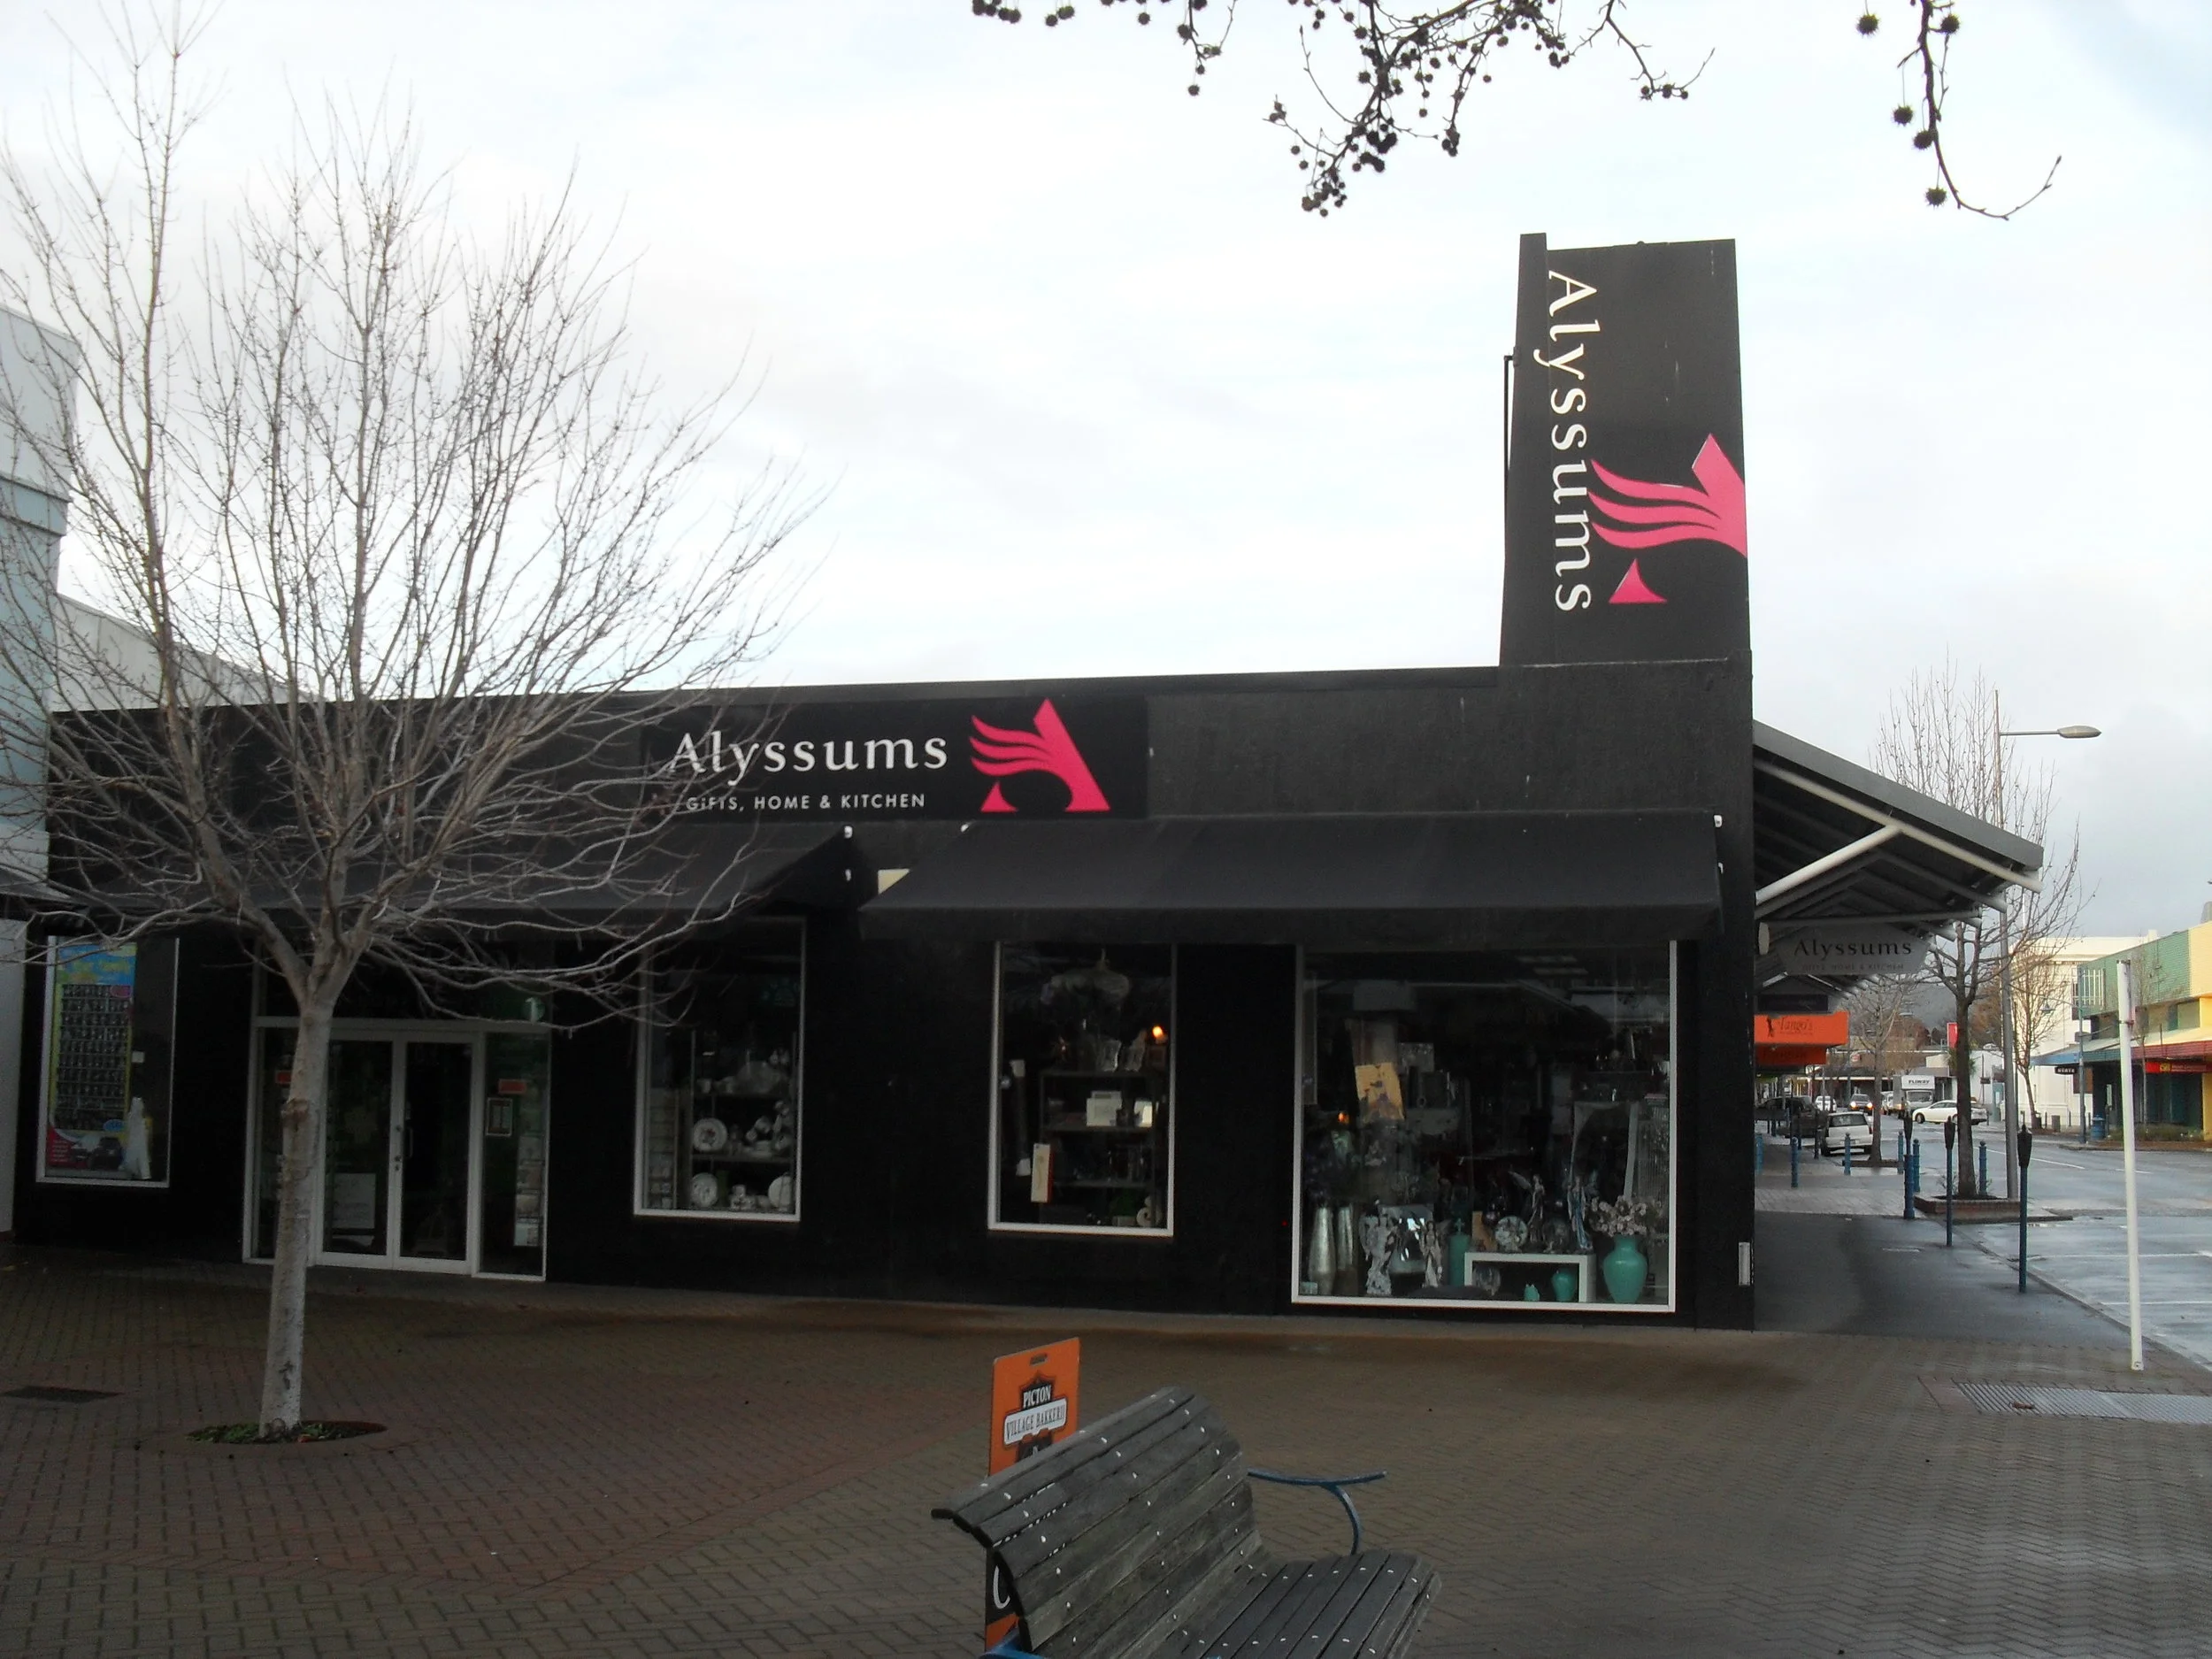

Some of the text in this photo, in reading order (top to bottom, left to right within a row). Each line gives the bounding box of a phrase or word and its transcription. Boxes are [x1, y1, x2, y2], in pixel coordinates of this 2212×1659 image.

[1533, 269, 1601, 611] Alyssums
[669, 730, 948, 787] Alyssums
[754, 795, 810, 810] HOME
[818, 795, 831, 809] &
[841, 794, 925, 809] KITCHEN
[1793, 939, 1911, 961] Alyssums
[1023, 1384, 1051, 1409] PICTON
[1006, 1414, 1034, 1440] VILLAGE
